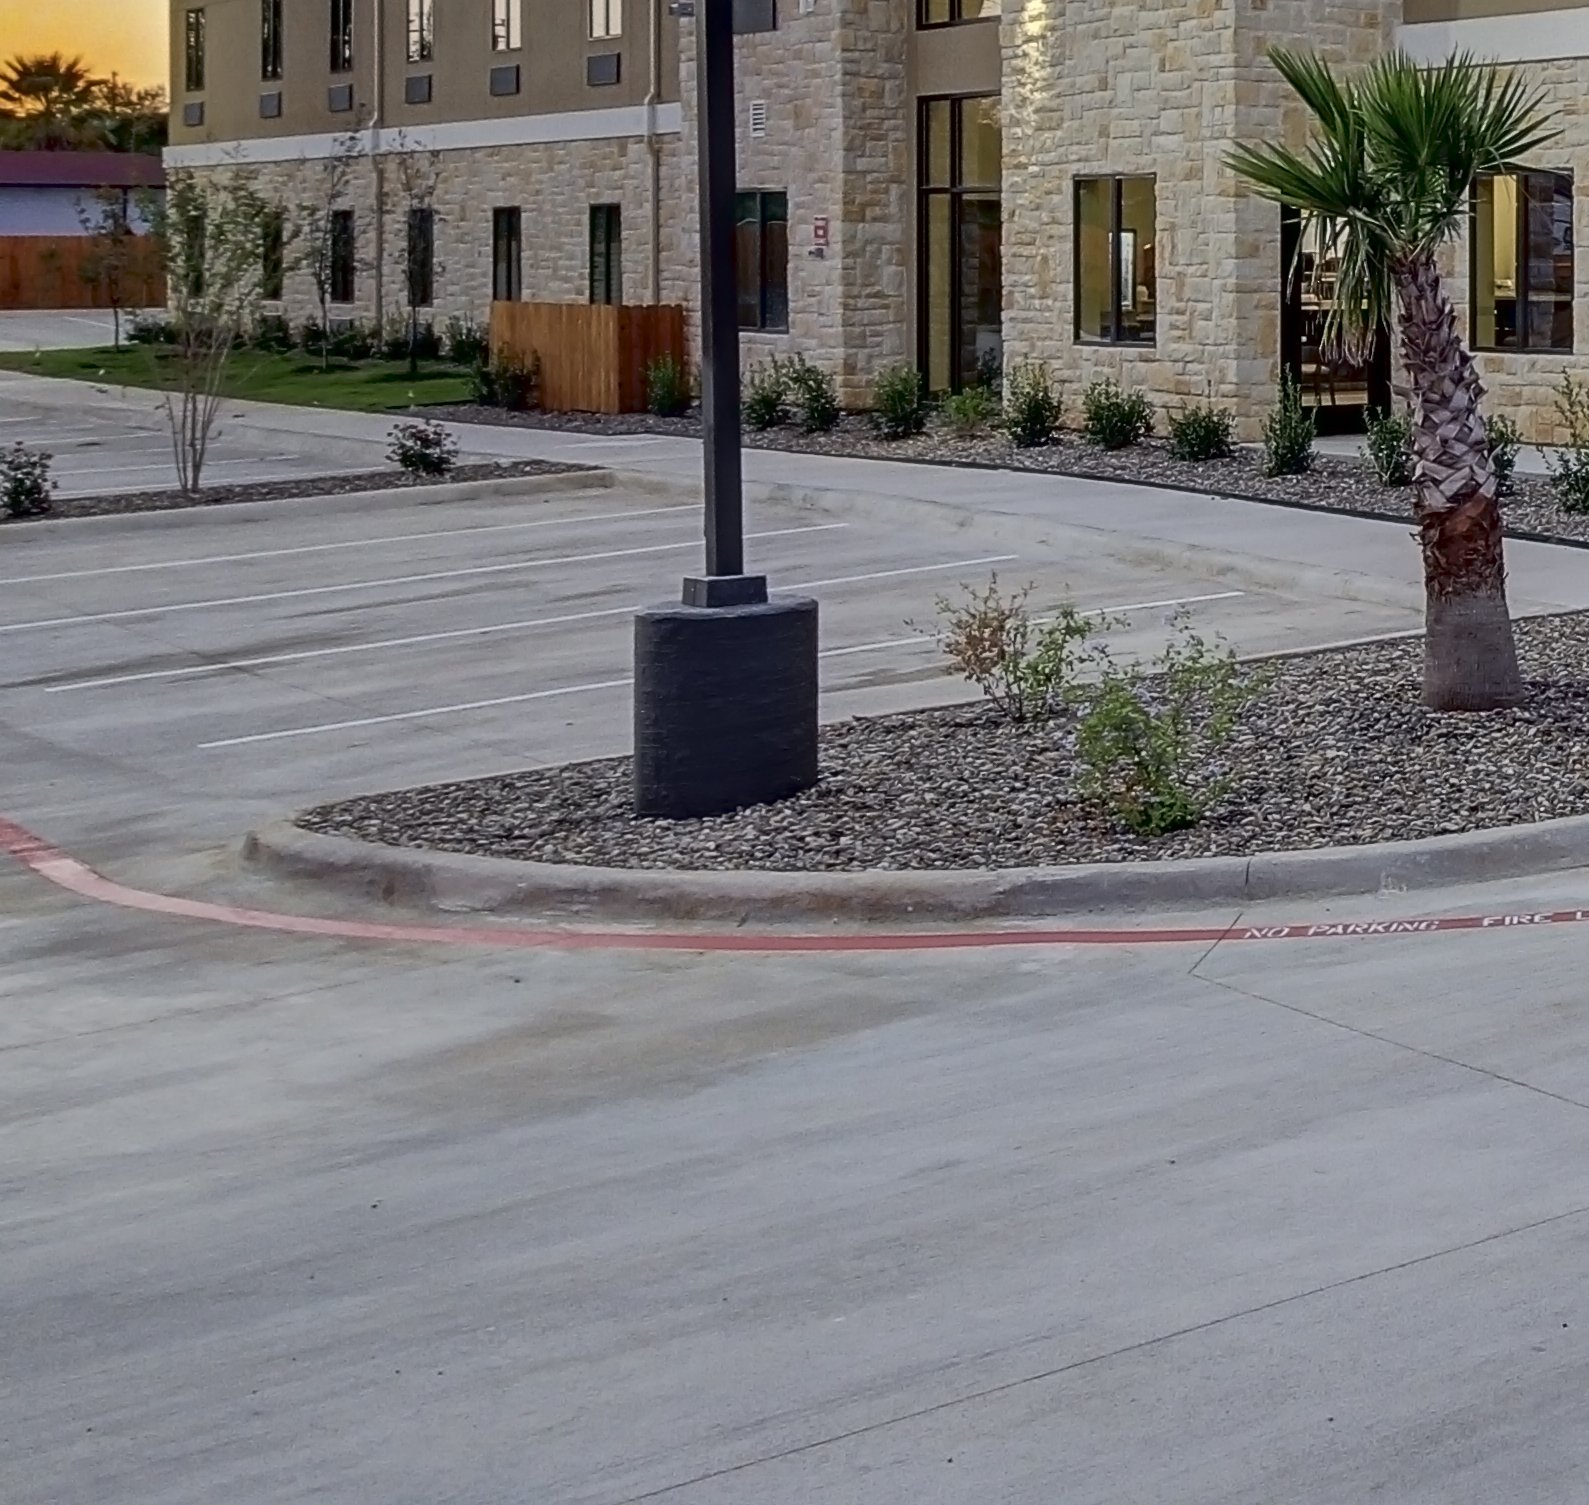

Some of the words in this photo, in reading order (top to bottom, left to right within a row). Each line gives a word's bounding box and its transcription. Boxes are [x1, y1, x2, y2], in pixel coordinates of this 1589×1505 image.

[1243, 925, 1291, 939] NO
[1306, 920, 1440, 937] PARKING
[1481, 912, 1552, 927] FIRE
